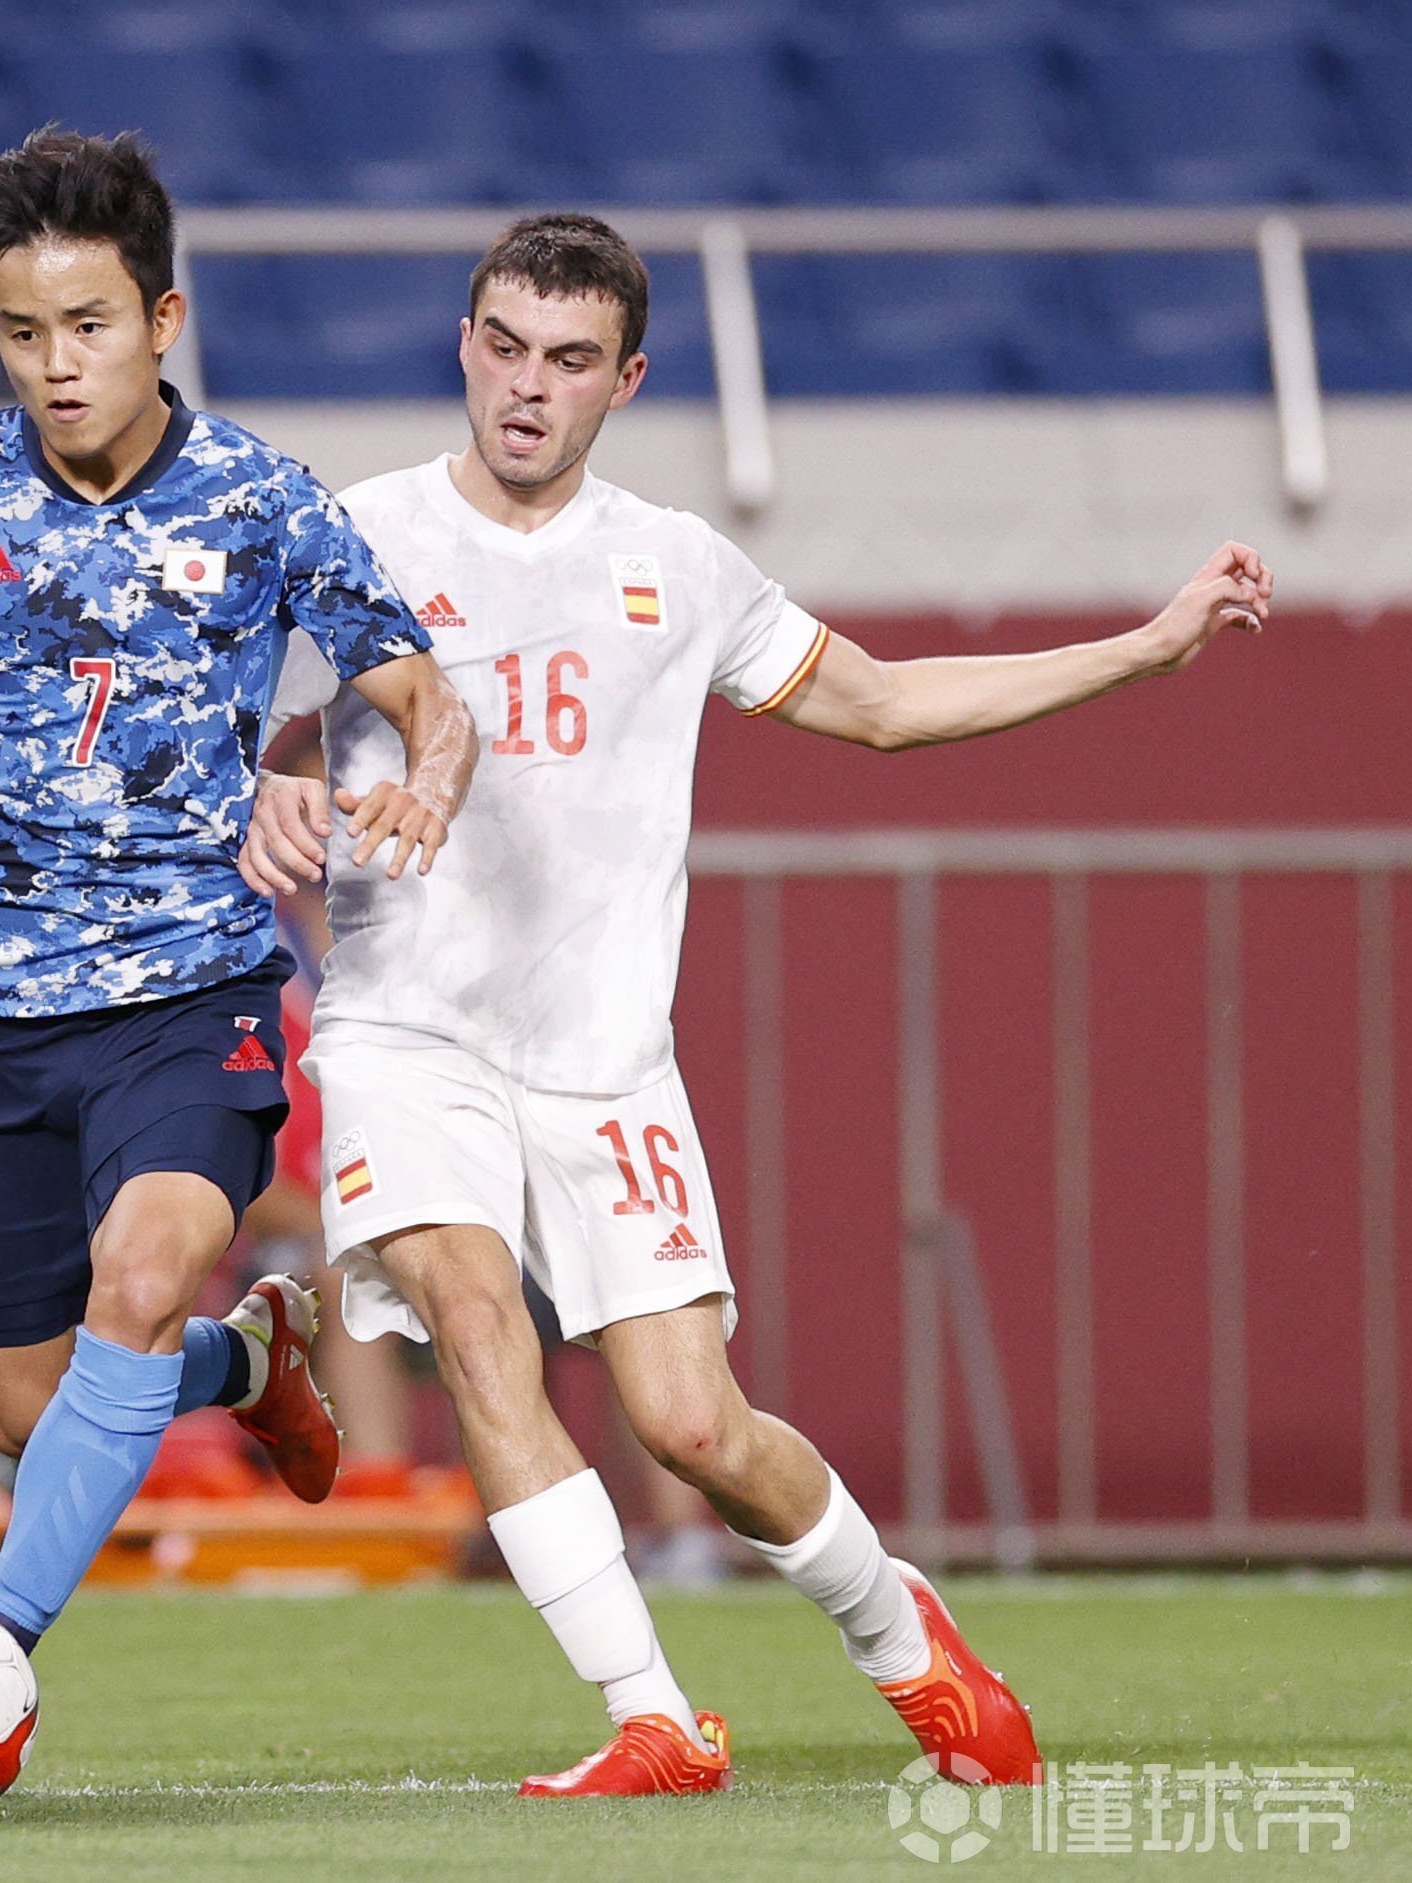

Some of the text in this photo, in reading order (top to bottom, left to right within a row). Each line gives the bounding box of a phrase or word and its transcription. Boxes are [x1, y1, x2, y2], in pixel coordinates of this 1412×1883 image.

[70, 657, 116, 768] 7
[491, 650, 589, 756] 16
[221, 1058, 276, 1072] adidas
[596, 1120, 689, 1218] 16
[654, 1247, 708, 1261] adidas
